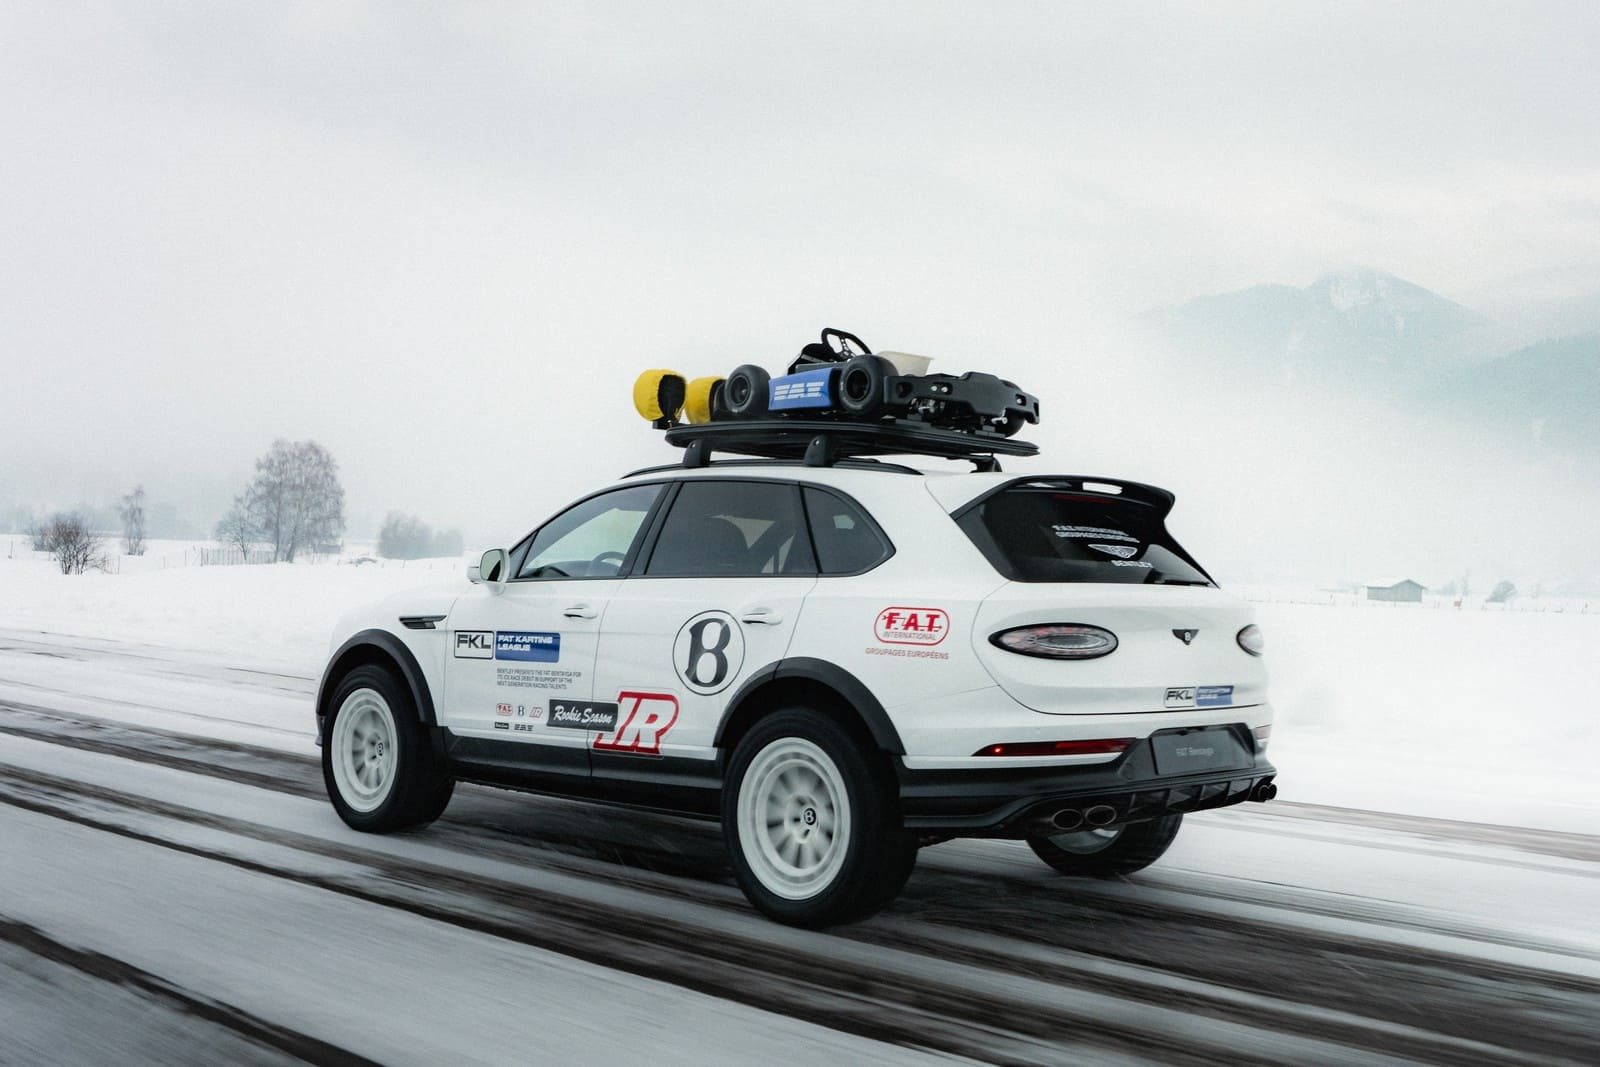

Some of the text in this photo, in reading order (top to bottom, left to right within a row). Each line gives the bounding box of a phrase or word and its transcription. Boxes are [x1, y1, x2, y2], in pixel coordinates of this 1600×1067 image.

[498, 635, 553, 644] FAT KARTING
[883, 631, 936, 640] INTERNATIONAL
[457, 634, 491, 649] FKL
[497, 643, 531, 651] LEAGUE
[865, 648, 905, 657] GROUPAGES
[1166, 690, 1193, 701] FKL
[553, 705, 612, 725] Rookie Season
